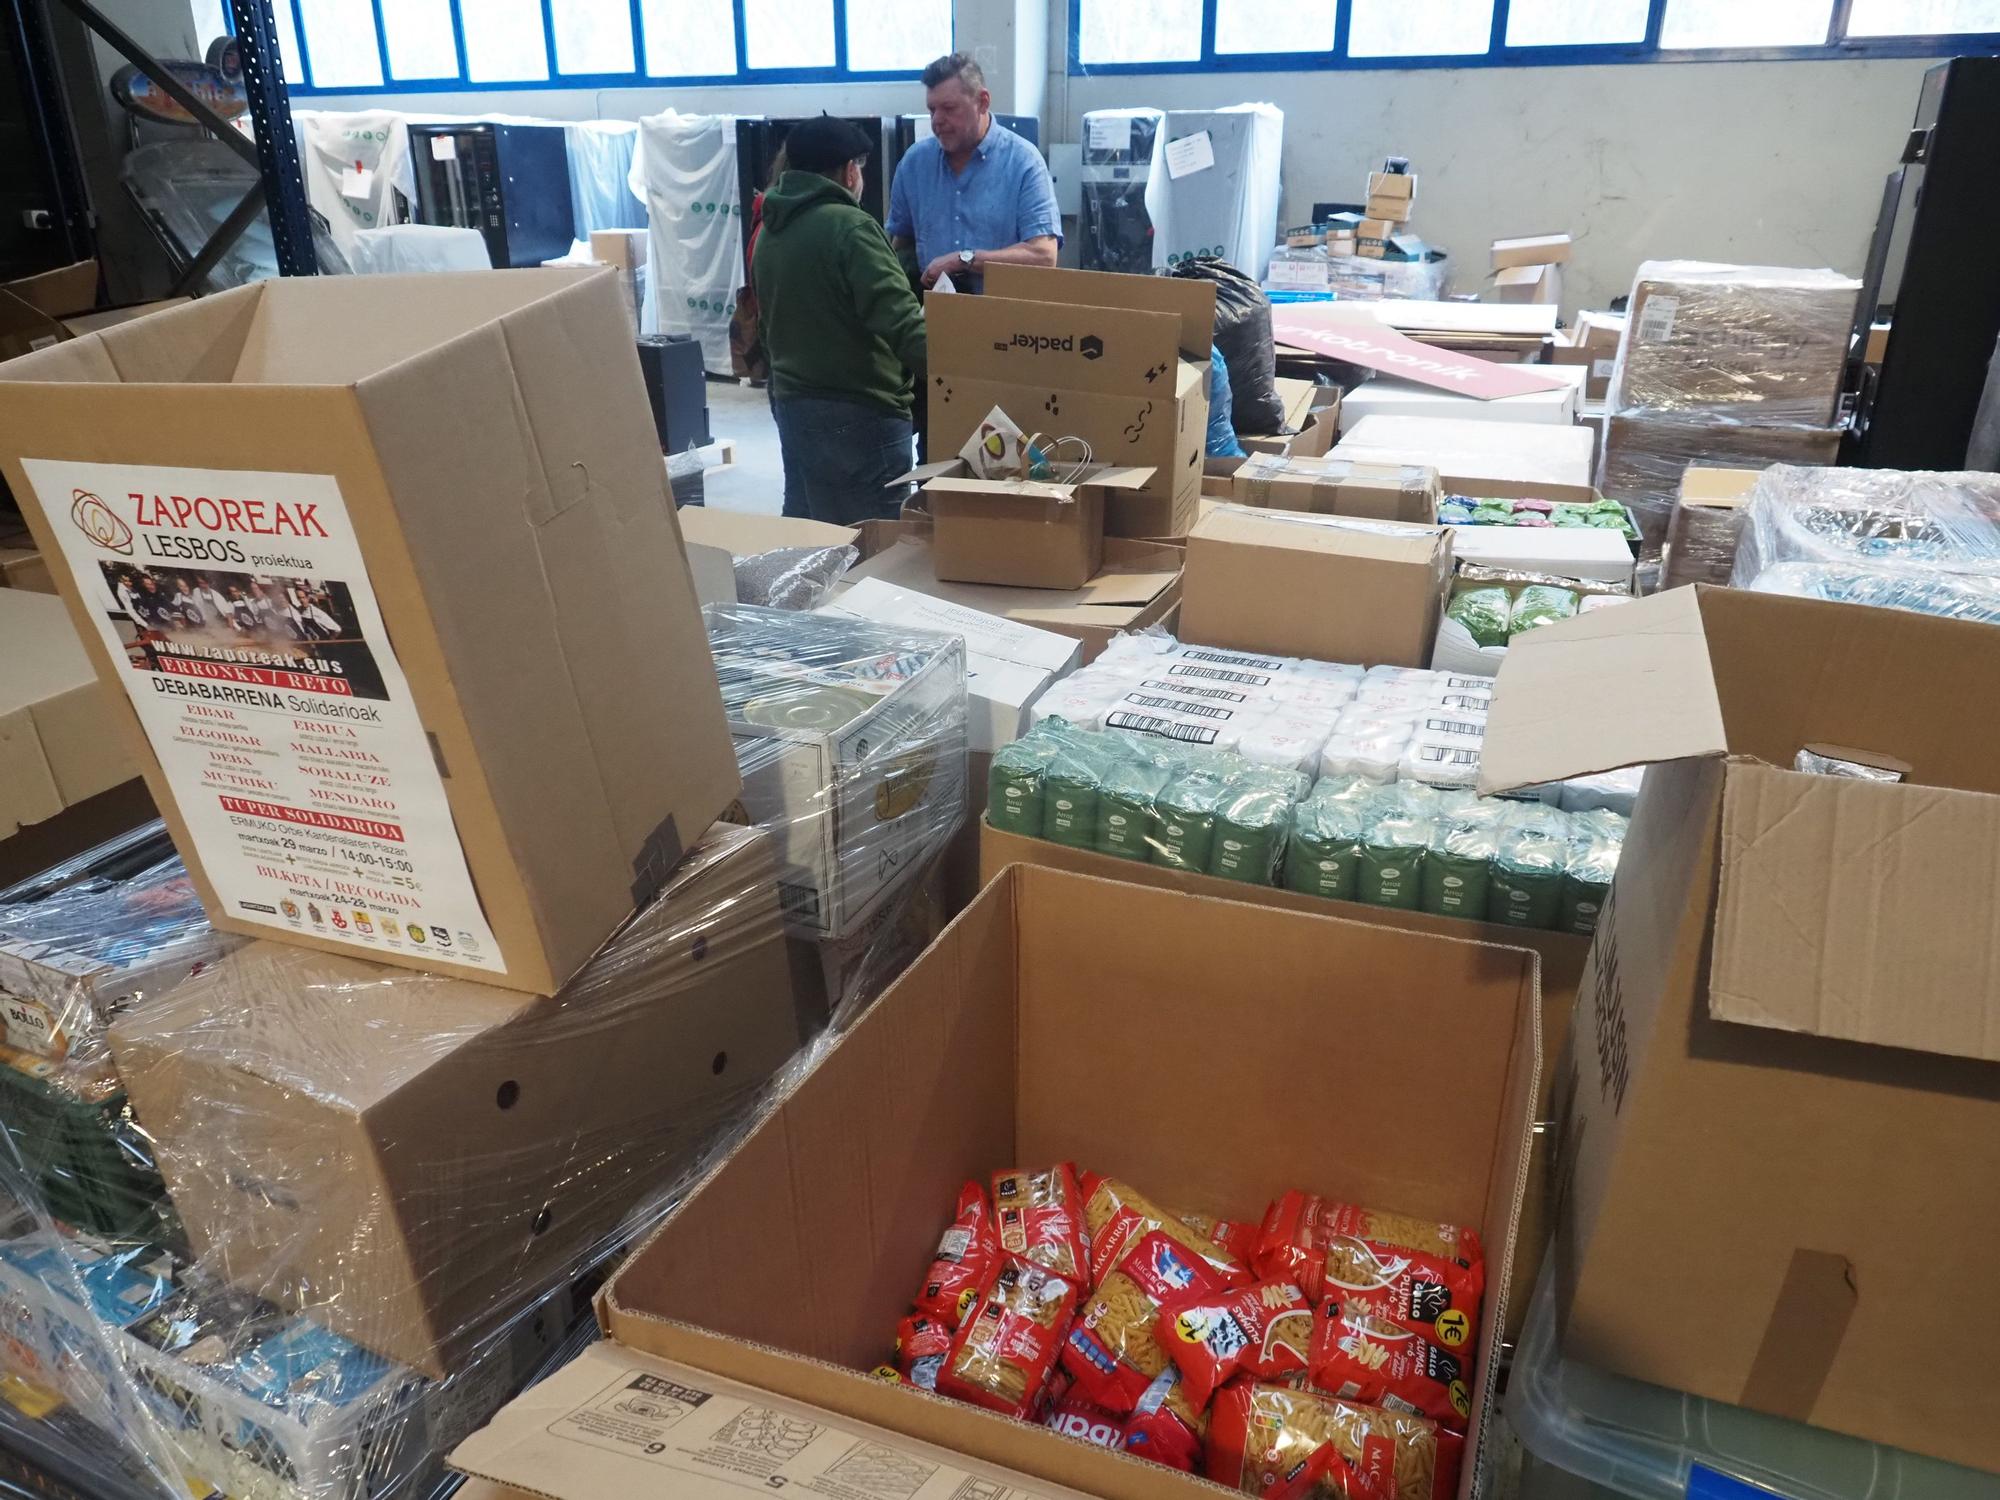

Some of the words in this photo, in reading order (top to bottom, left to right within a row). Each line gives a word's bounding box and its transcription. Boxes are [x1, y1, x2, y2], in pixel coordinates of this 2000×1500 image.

[1010, 334, 1074, 354] packer
[128, 493, 328, 537] ZAPOREAK
[142, 533, 246, 562] LESBOS
[250, 553, 314, 570] proiektua
[151, 640, 344, 673] www.zaporeak.eus
[161, 658, 264, 685] ERRONKA
[287, 673, 348, 694] RETO
[152, 676, 285, 709] DEBABARRENA
[288, 695, 382, 722] Solidarioak
[186, 704, 235, 720] EIBAR
[180, 726, 262, 746] ELGOIBAR
[293, 720, 357, 737] ERMUA
[209, 751, 253, 765] DEBA
[290, 742, 380, 763] MALLABIA
[203, 770, 278, 790] MUTRIKU
[298, 765, 391, 787] SORALUZE
[309, 788, 397, 810] MENDARO
[222, 797, 282, 817] TUPER
[284, 808, 402, 839] SOLIDARIOA
[230, 815, 276, 831] ERMUKO
[1056, 811, 1073, 820] Arroz
[1110, 825, 1127, 835] Arroz
[238, 833, 280, 847] martxoak
[281, 837, 296, 849] 29
[298, 845, 327, 855] marzo
[341, 849, 413, 873] 14:00-15:00
[257, 865, 321, 888] BILKETA
[335, 881, 421, 908] RECOGIDA
[1381, 880, 1400, 888] Arroz
[289, 888, 331, 902] martxoak
[369, 903, 400, 915] marzo
[1397, 1273, 1411, 1320] PLUMAS
[1232, 1305, 1262, 1344] PLUMAS
[1442, 1314, 1465, 1341] 1€
[1414, 1336, 1427, 1377] PLUMAS
[1429, 1346, 1438, 1377] GALLO
[1455, 1385, 1470, 1416] 1€
[644, 1442, 666, 1456] 6
[1370, 1447, 1381, 1481] MAC
[765, 1475, 789, 1489] 5
